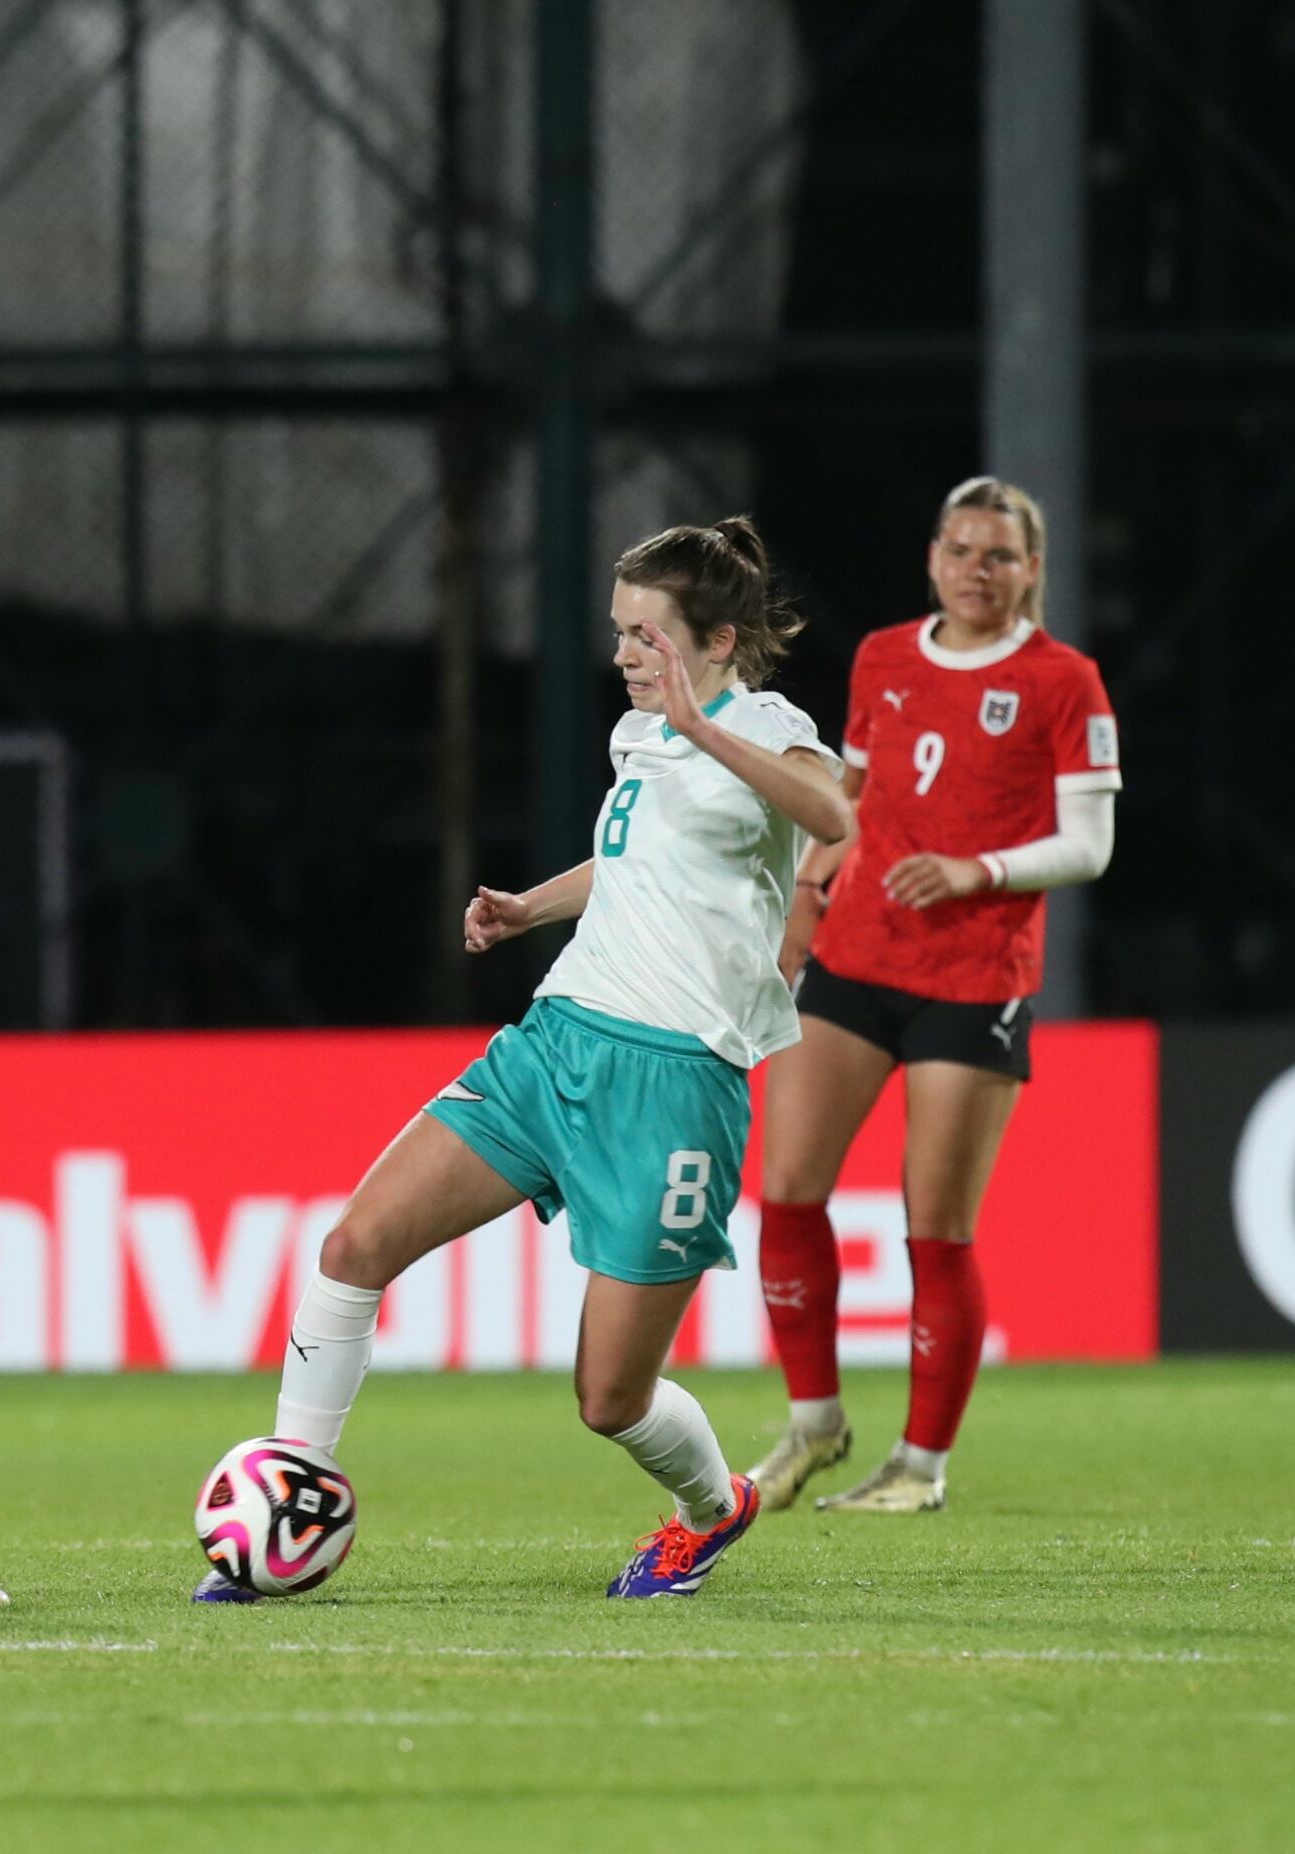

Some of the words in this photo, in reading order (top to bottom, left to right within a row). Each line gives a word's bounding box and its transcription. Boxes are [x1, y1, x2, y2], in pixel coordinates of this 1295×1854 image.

[914, 731, 946, 796] 9
[601, 779, 643, 857] 8
[659, 1149, 712, 1229] 8
